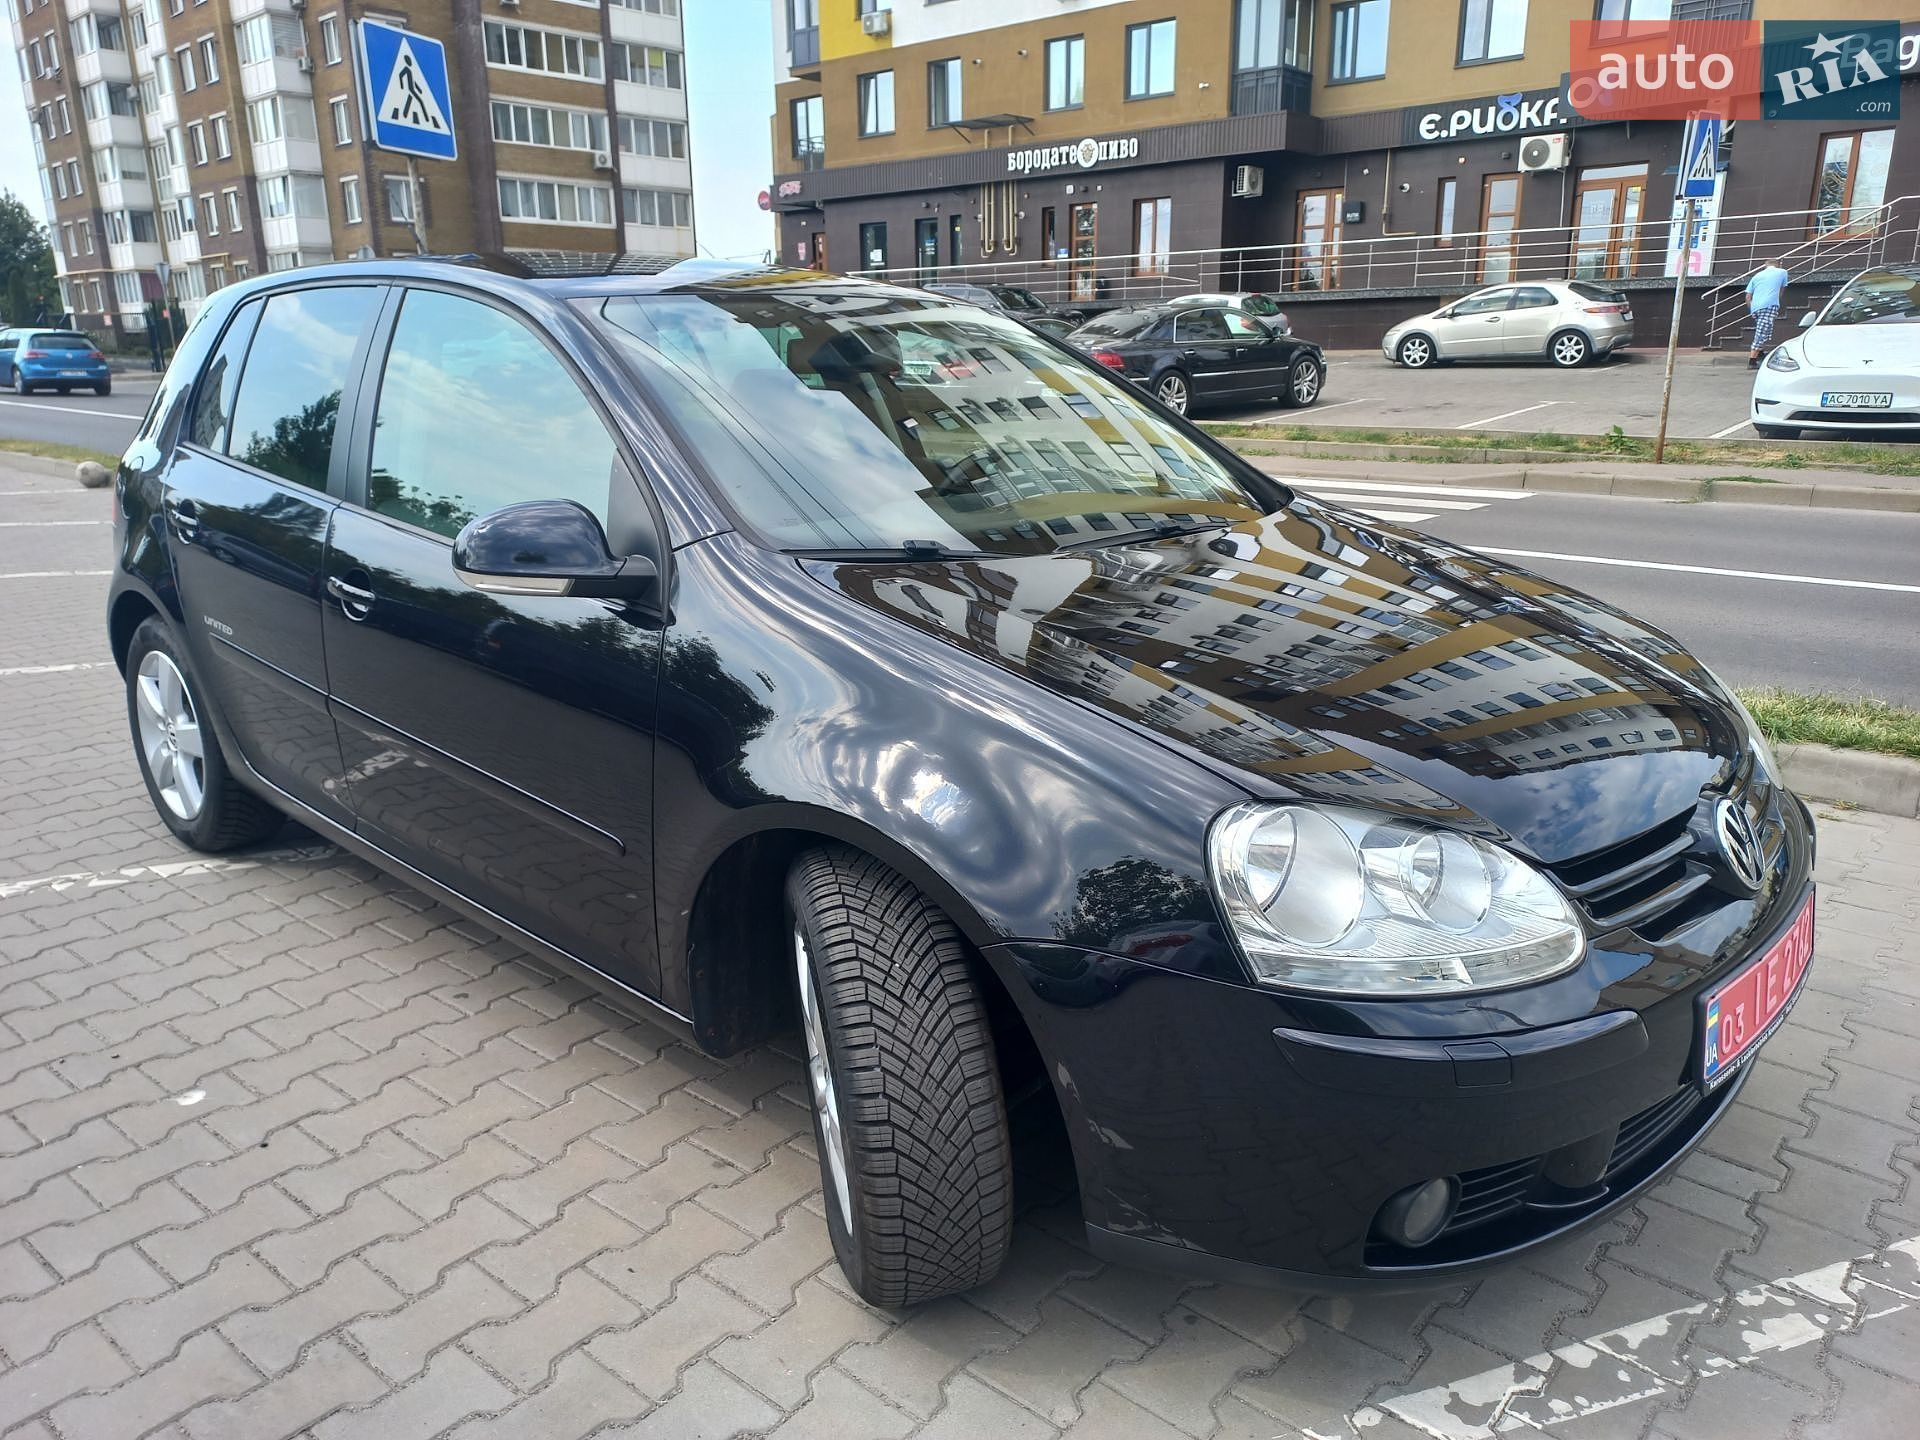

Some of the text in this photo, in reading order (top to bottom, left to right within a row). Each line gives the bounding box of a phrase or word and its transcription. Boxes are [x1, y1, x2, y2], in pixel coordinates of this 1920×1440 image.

[1846, 394, 1871, 404] 7010
[1722, 1002, 1745, 1054] 03
[1754, 953, 1779, 1027] IE
[1706, 1042, 1718, 1067] UA
